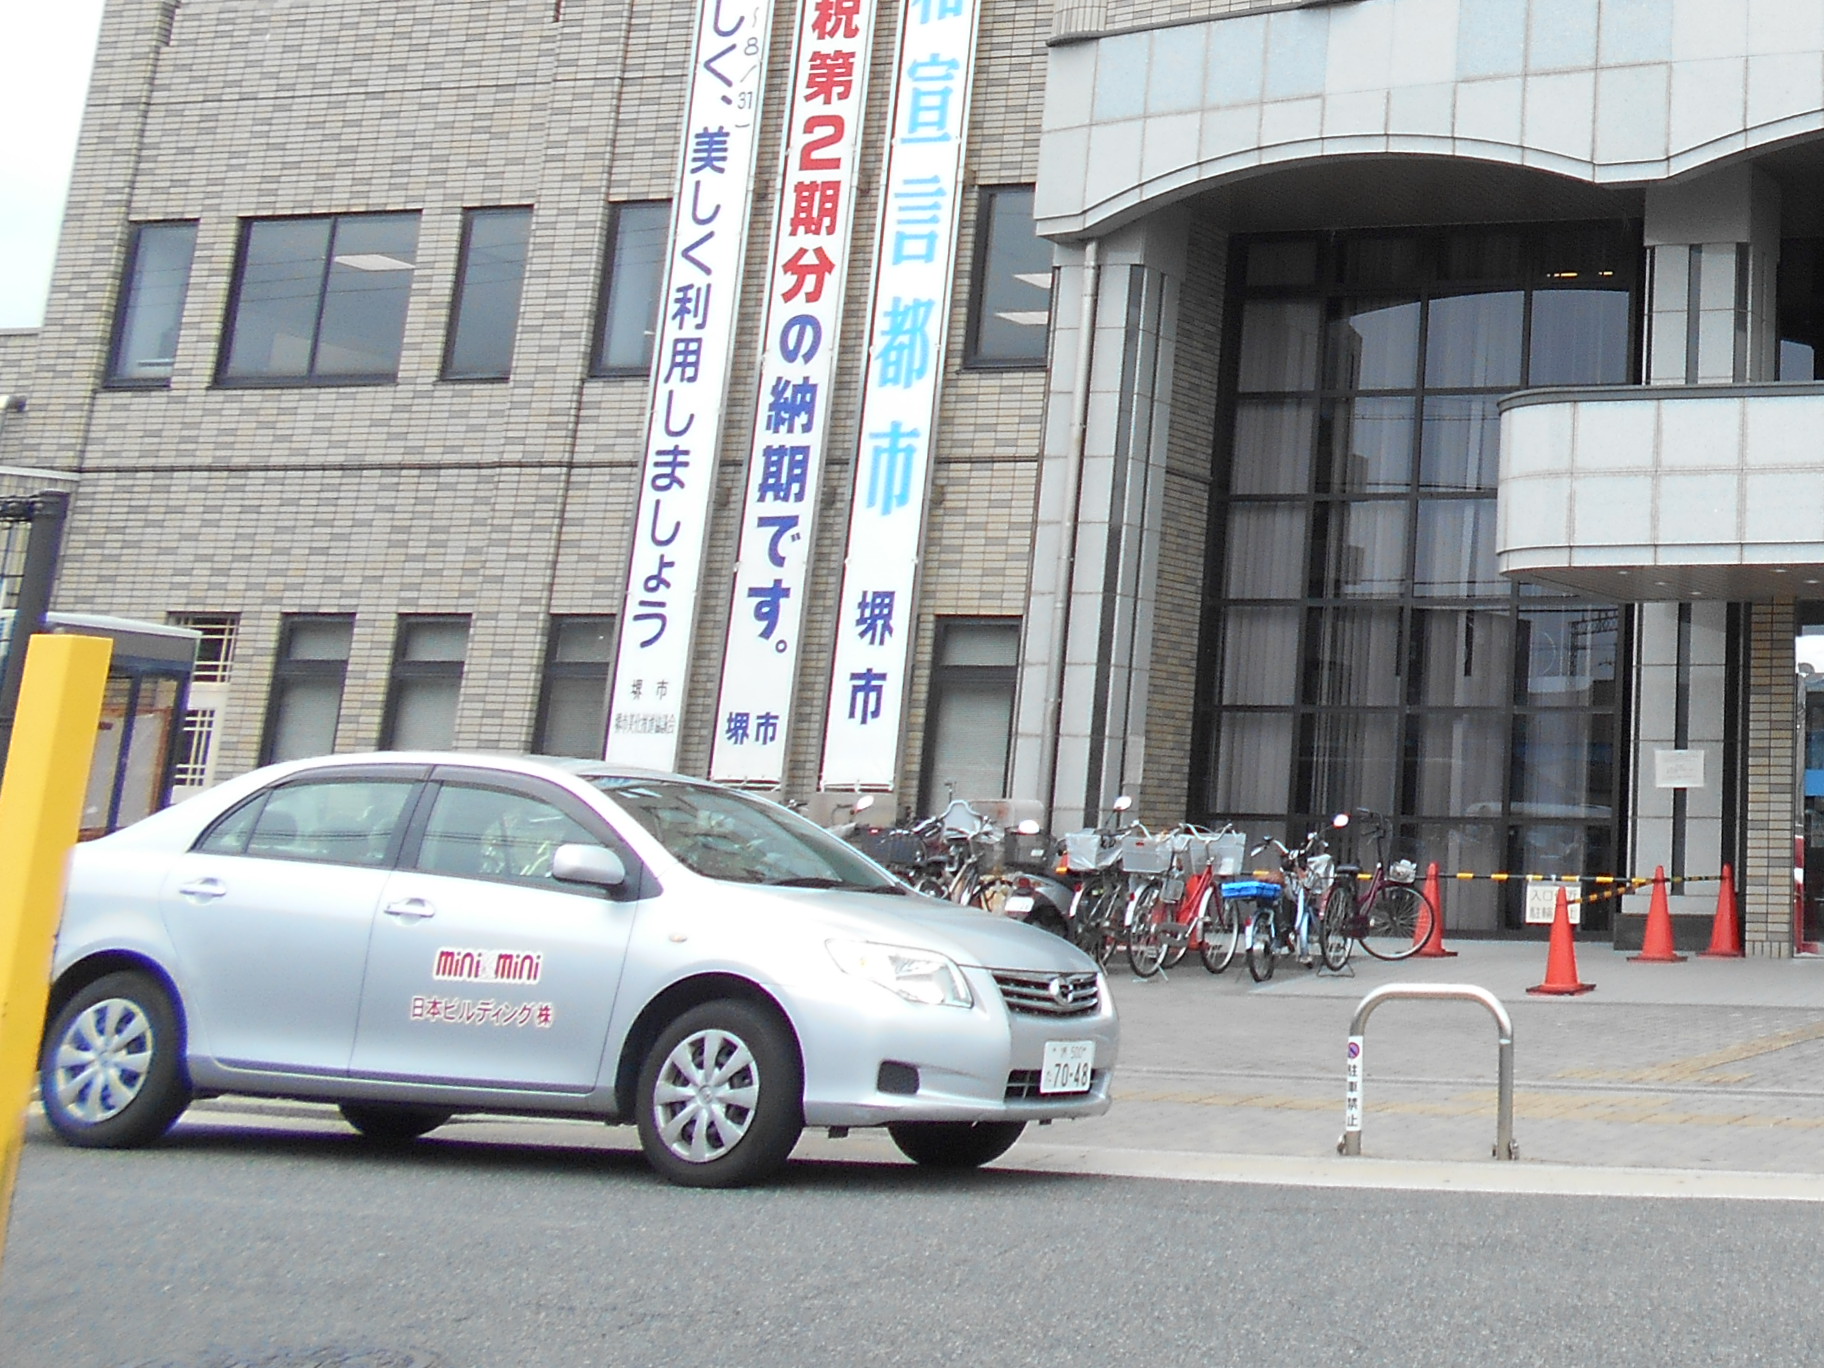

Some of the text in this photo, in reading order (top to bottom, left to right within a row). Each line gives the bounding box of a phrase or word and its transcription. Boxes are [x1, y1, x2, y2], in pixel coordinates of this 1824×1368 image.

[847, 589, 896, 725] 堺市
[725, 710, 780, 746] 堺市
[435, 950, 542, 981] mini mini
